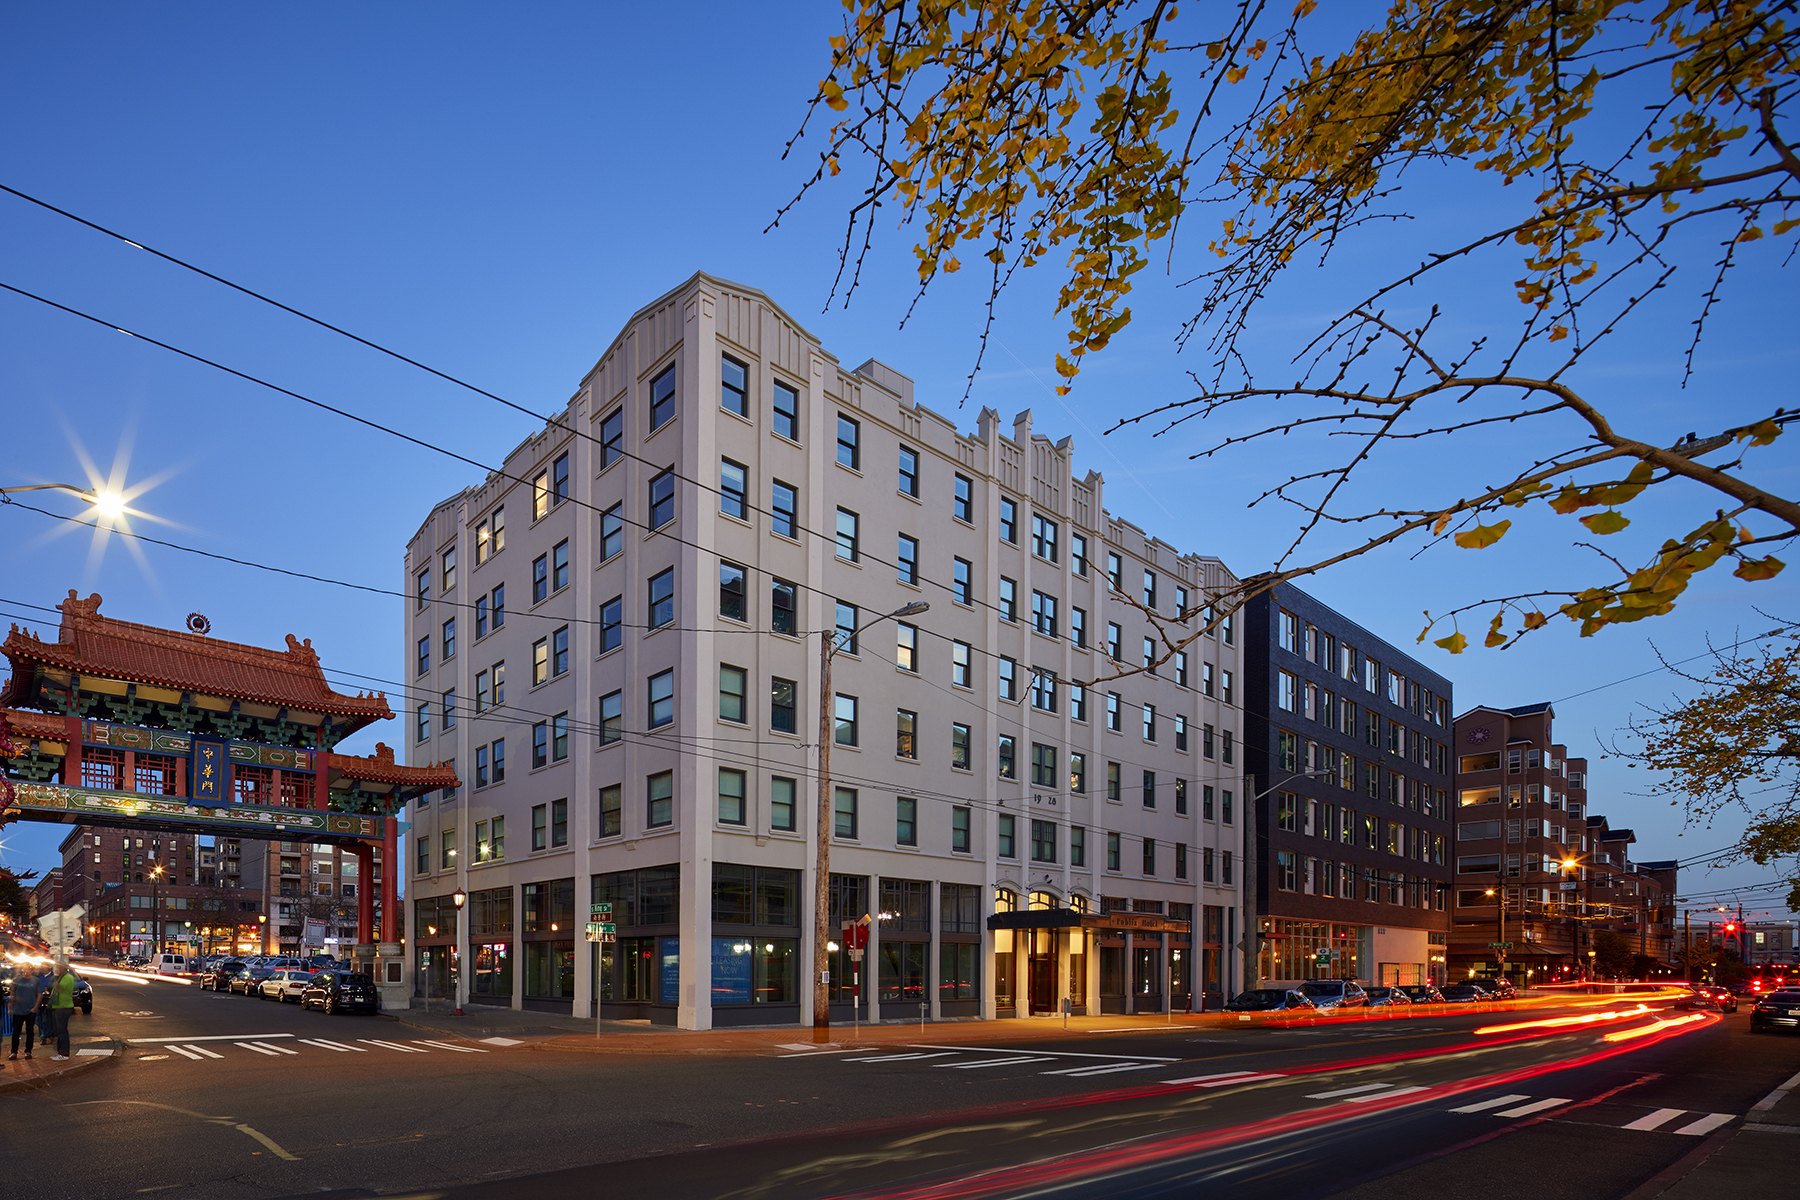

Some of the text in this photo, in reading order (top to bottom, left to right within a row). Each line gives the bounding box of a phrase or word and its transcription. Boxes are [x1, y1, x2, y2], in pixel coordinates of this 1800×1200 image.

[202, 748, 214, 794] 中華門
[1116, 917, 1158, 928] Publix Hotel
[715, 956, 743, 965] LEASING
[720, 966, 738, 975] NOW
